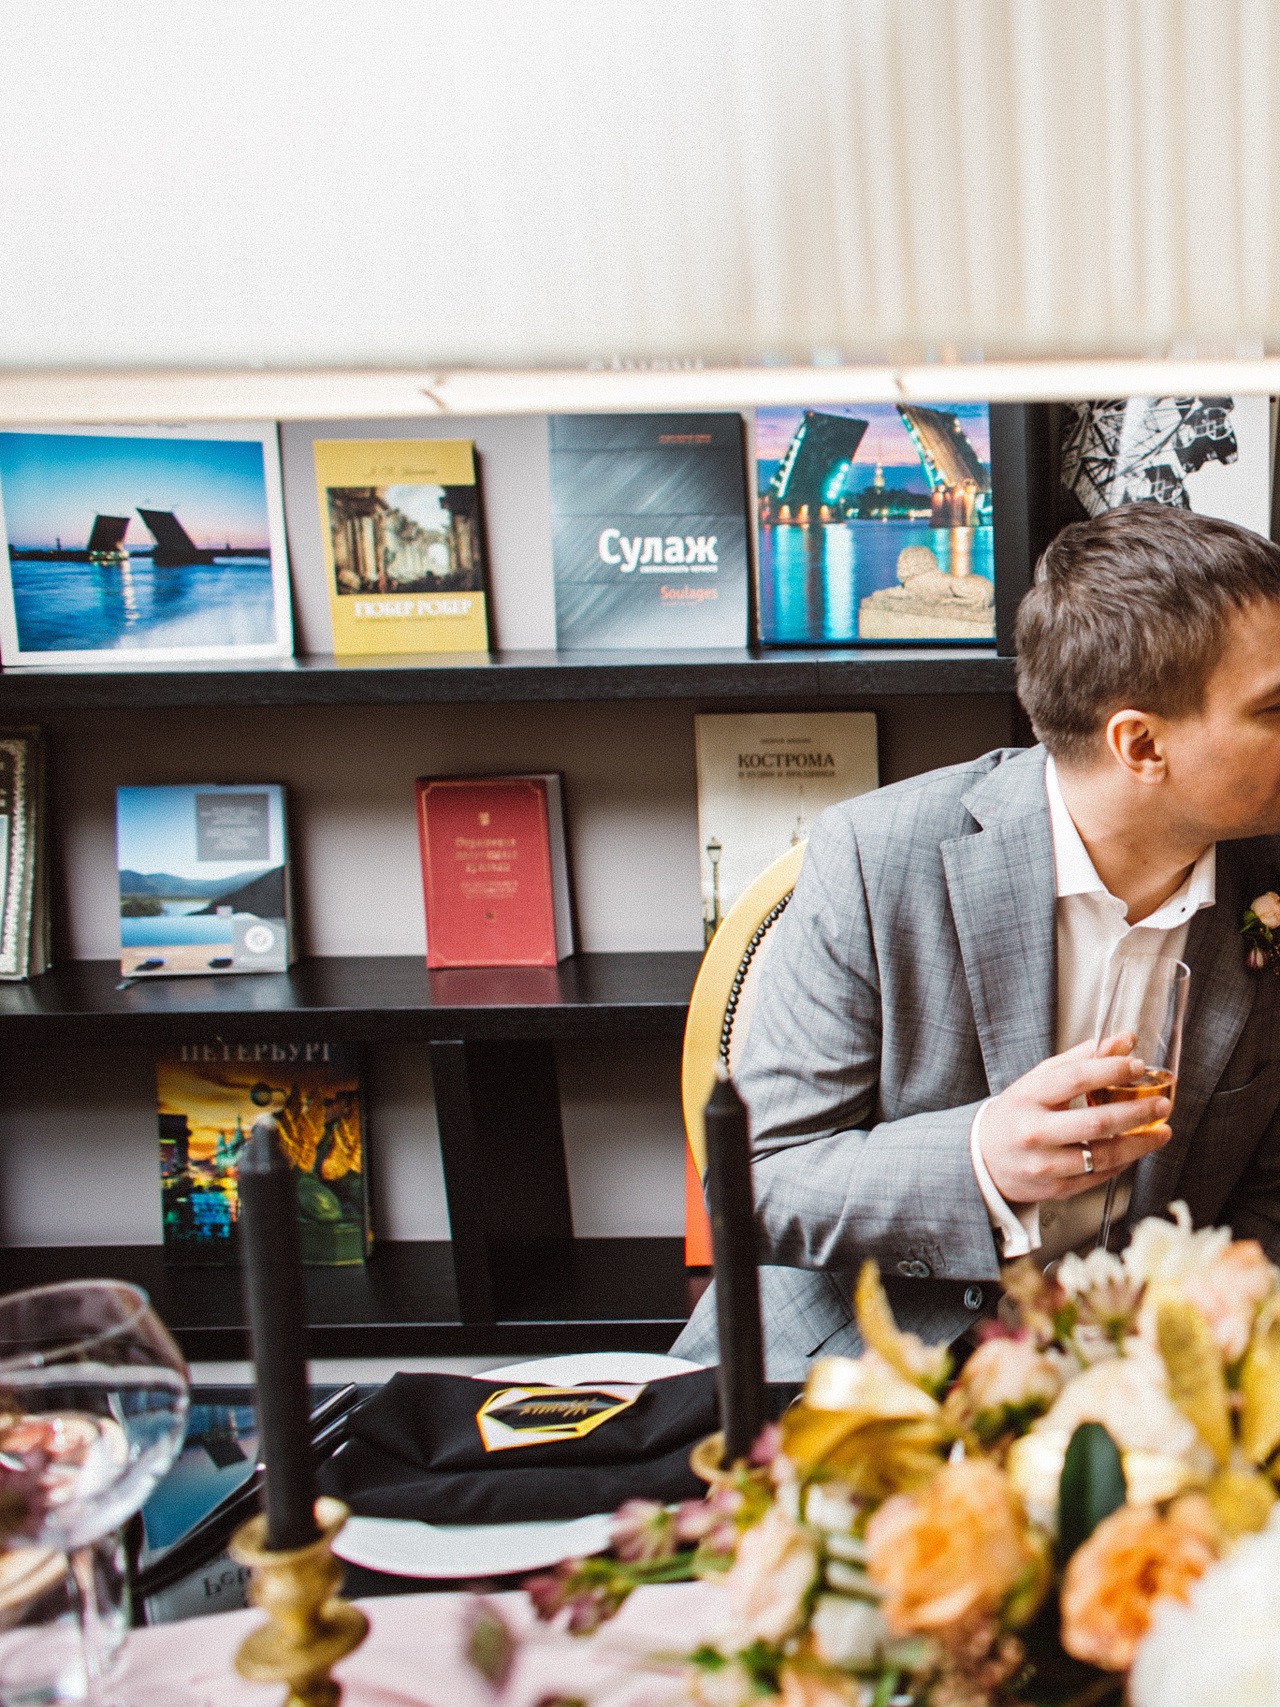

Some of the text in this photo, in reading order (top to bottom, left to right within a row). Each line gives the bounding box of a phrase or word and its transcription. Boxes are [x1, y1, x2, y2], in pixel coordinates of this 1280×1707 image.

[598, 528, 719, 573] Сулаж
[659, 585, 718, 603] Soulages
[737, 753, 836, 768] КОСТРОМА
